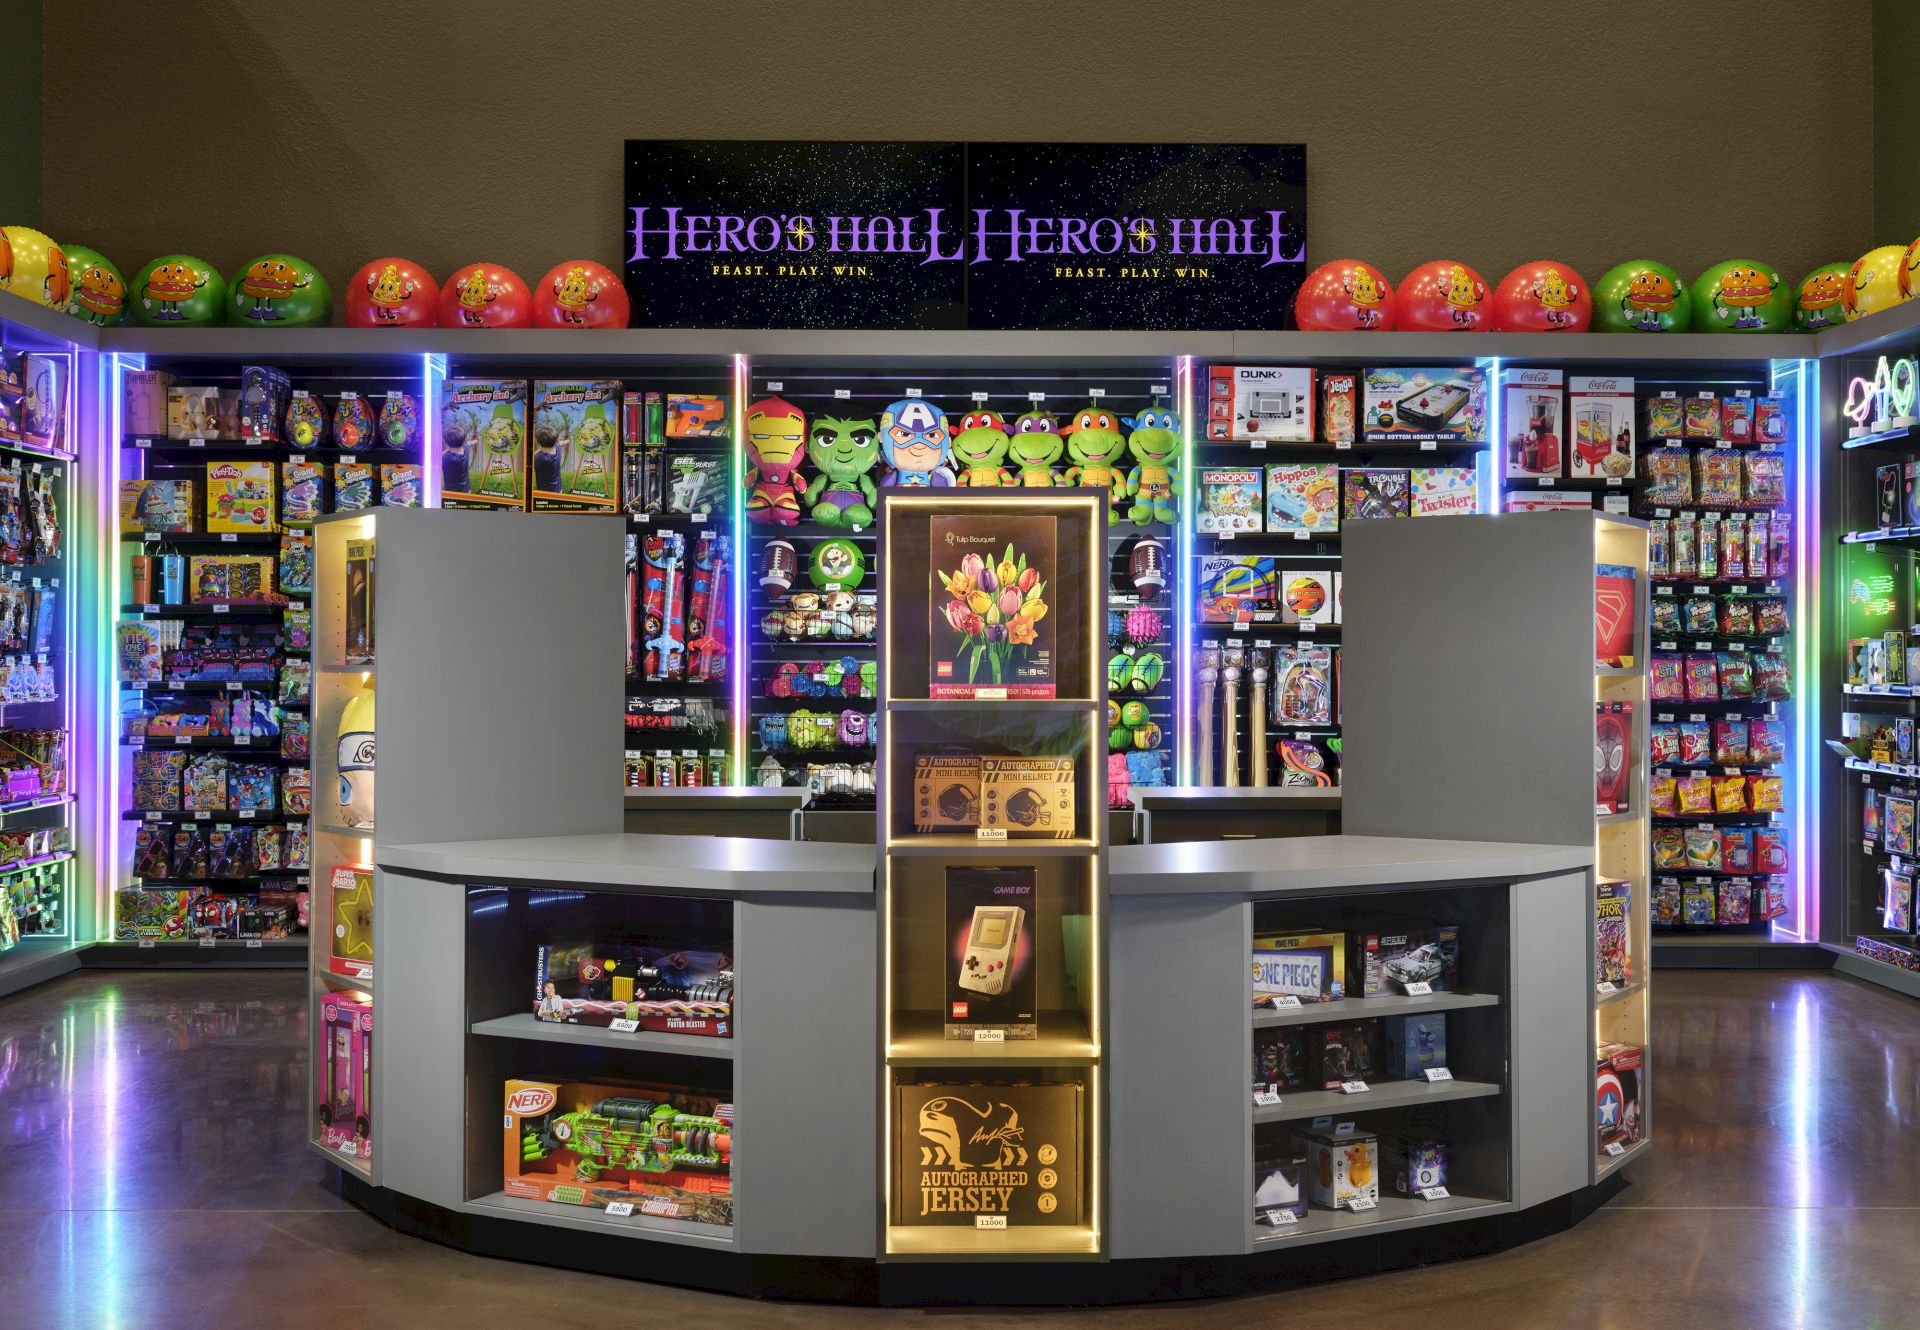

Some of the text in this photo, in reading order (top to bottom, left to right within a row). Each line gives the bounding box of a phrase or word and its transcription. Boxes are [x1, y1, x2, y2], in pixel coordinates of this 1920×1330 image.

[626, 207, 963, 265] HERO'S HALL
[969, 208, 1305, 268] HERO'S HALL
[712, 265, 874, 276] FEAST. PLAY. WIN.
[1055, 267, 1216, 278] FEAST. PLAY. WIN.
[127, 374, 157, 382] TUMBLER
[1241, 370, 1277, 379] DUNK
[1521, 371, 1550, 382] Coca-Cola
[1331, 378, 1353, 393] Jenga
[1589, 379, 1618, 390] Coca-Cola
[452, 391, 509, 403] Archery Set
[545, 391, 601, 403] Archery Set
[292, 402, 317, 417] PUTTY
[386, 402, 411, 417] PUTTY
[673, 457, 695, 465] GEL
[293, 468, 314, 478] Giant
[345, 469, 366, 478] Giant
[392, 470, 413, 479] Giant
[1205, 473, 1256, 481] MONOPOLY
[1273, 467, 1317, 483] Hippos
[1368, 474, 1406, 484] TROUBLE
[1418, 496, 1471, 513] Twister
[1204, 560, 1233, 571] NERF
[126, 635, 142, 643] TIE
[1722, 662, 1736, 670] Fun
[1001, 761, 1056, 770] AUTOGRAPHED
[935, 769, 979, 777] MINI HELME
[1003, 773, 1053, 781] MINI HELMET
[336, 870, 354, 878] SUPER
[334, 878, 356, 888] MARIO
[994, 886, 1031, 894] GAME BOY
[1251, 962, 1318, 988] ONE PIECE
[507, 1093, 552, 1109] NERF
[920, 1171, 1028, 1186] AUTOGRAPHED
[920, 1187, 1014, 1216] JERSEY
